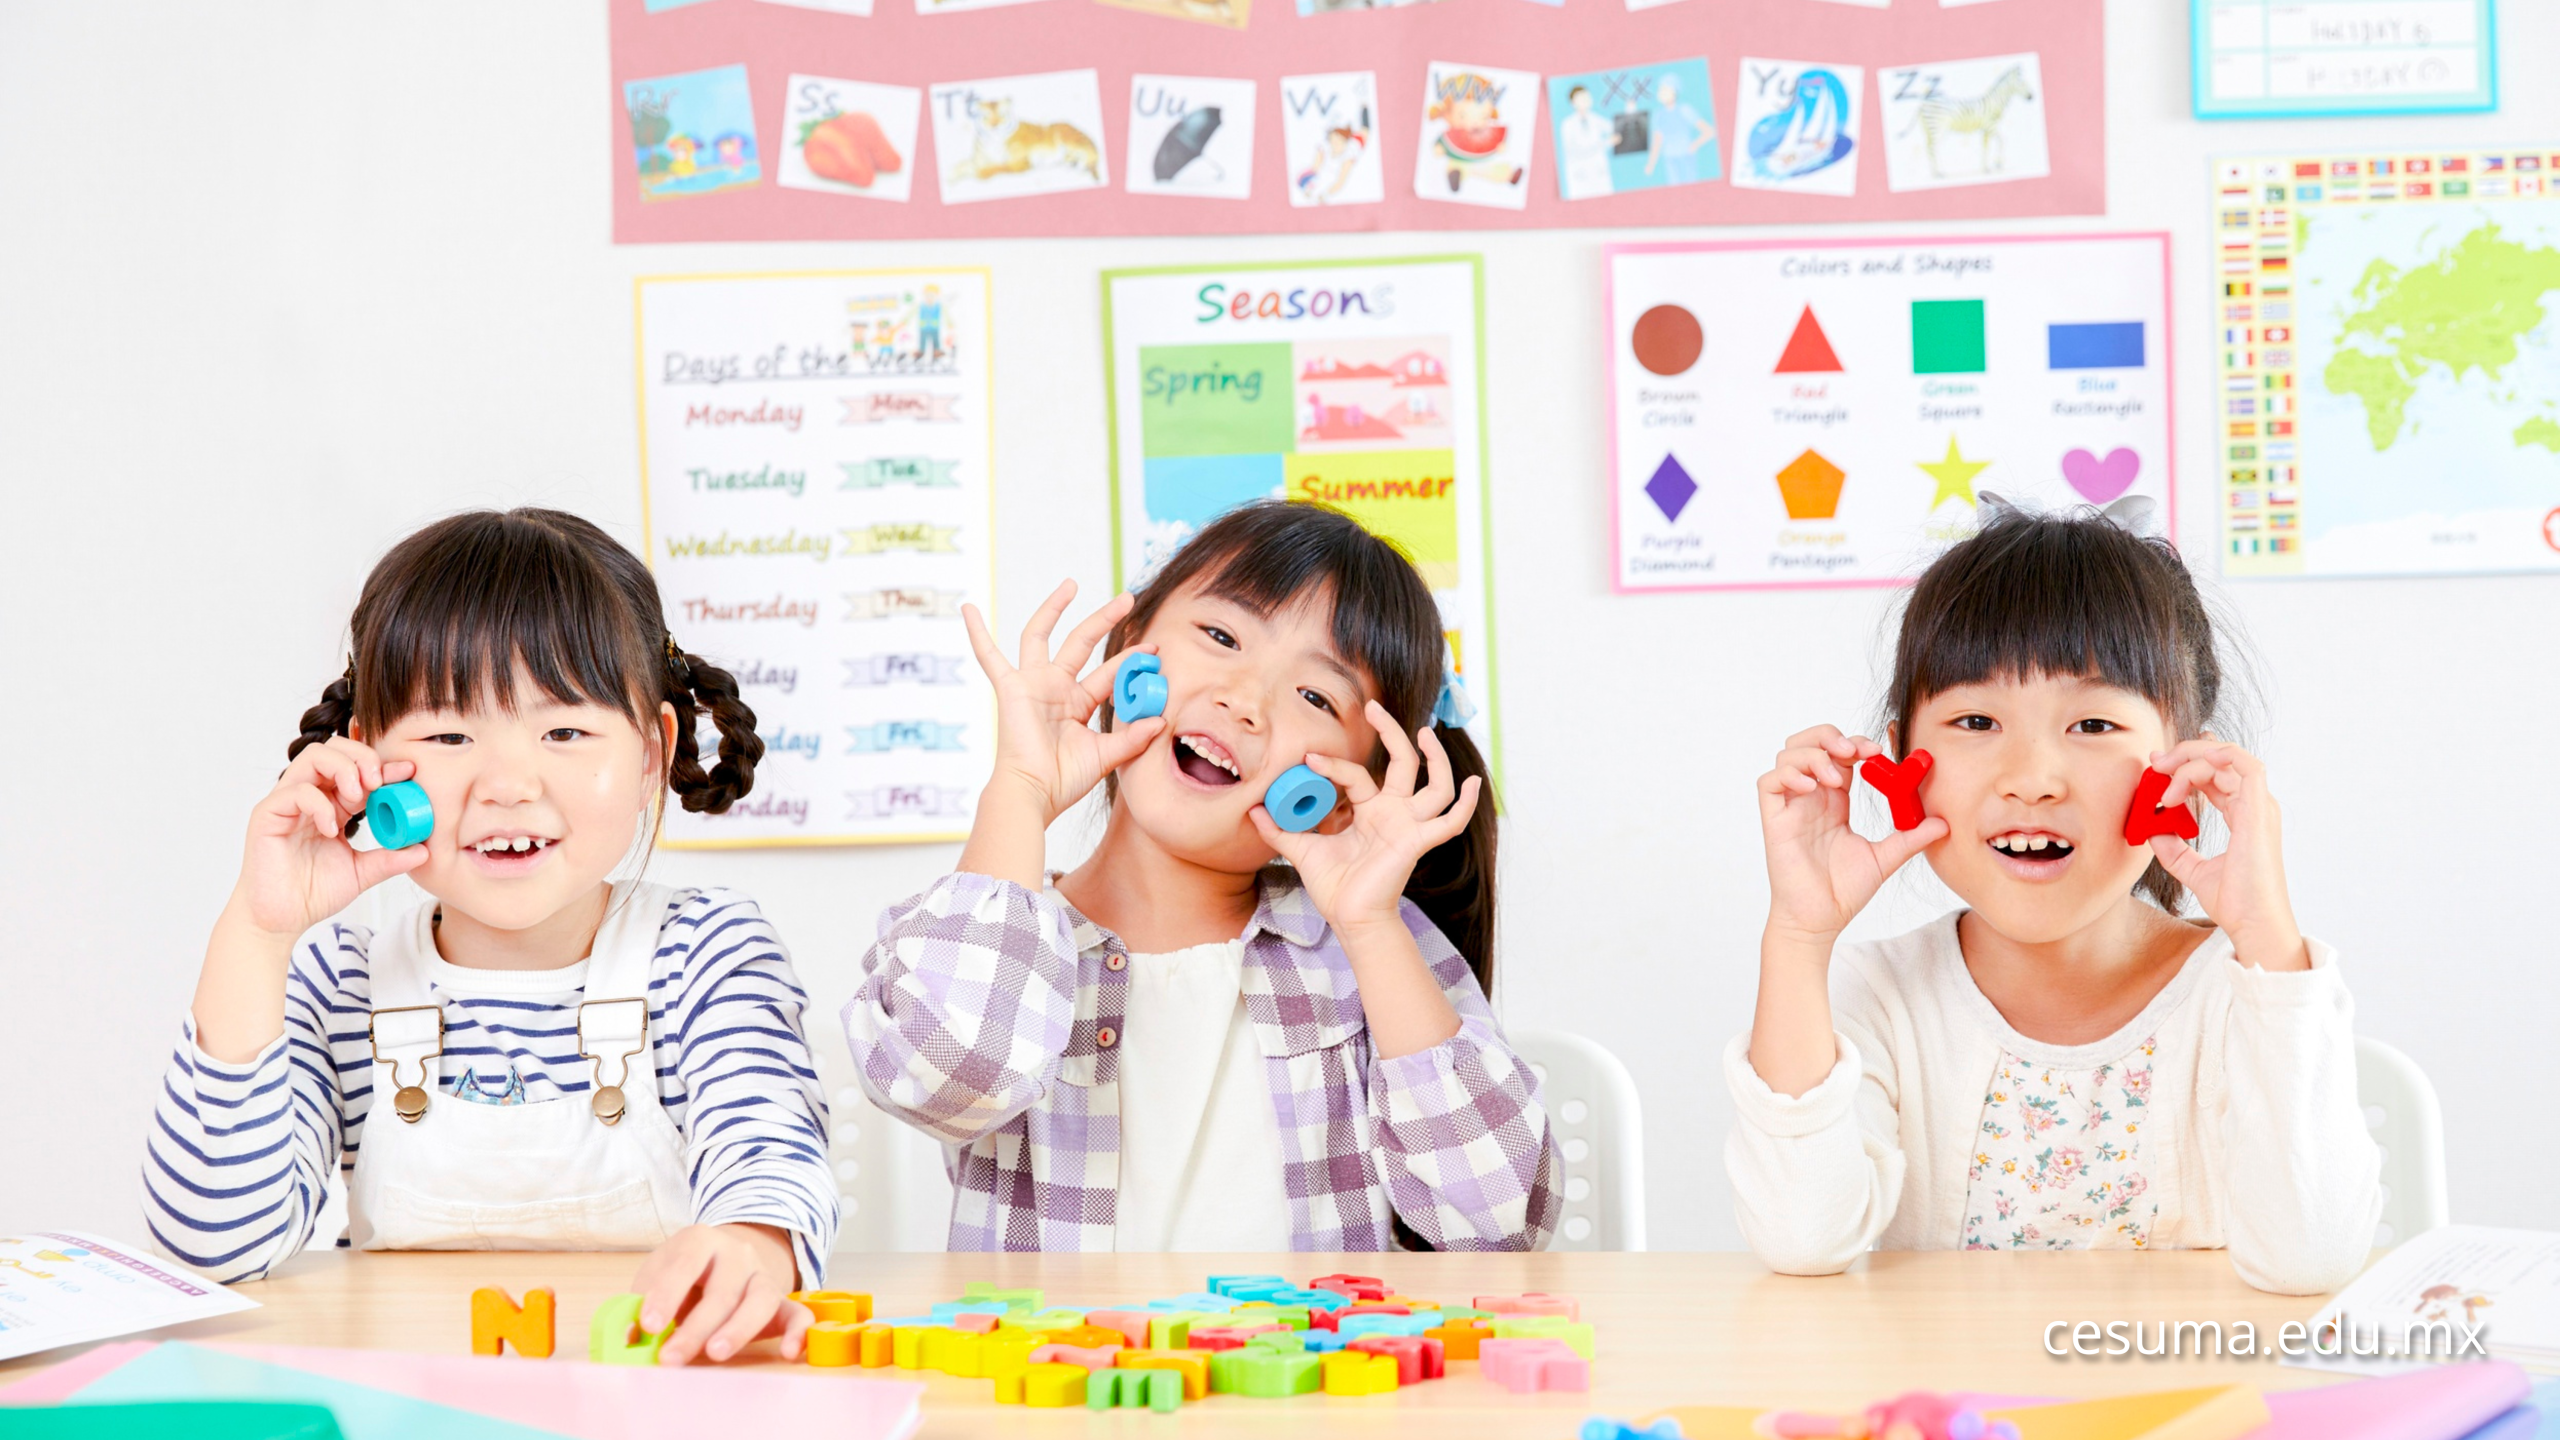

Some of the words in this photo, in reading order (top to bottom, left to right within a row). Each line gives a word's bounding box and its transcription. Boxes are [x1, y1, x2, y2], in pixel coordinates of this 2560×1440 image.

[797, 81, 839, 117] Ss
[1601, 72, 1653, 107] Xx
[1893, 70, 1942, 100] Zz
[936, 90, 981, 120] Tt
[1135, 86, 1188, 118] Uu
[1780, 256, 1851, 278] Colors
[1860, 252, 1905, 275] and
[1914, 253, 1993, 280] Shapes
[1197, 284, 1396, 323] Seasons
[664, 352, 740, 384] Days
[755, 343, 786, 379] of
[799, 345, 848, 376] the
[1145, 363, 1262, 405] Spring
[1790, 382, 1829, 400] Red
[685, 397, 803, 432] Monday
[686, 464, 806, 497] Tuesday
[1300, 474, 1455, 504] Summer
[665, 530, 831, 561] Wednesday
[682, 593, 818, 627] Thursday
[735, 659, 797, 693] iday
[702, 793, 808, 825] nday
[471, 1286, 556, 1359] N
